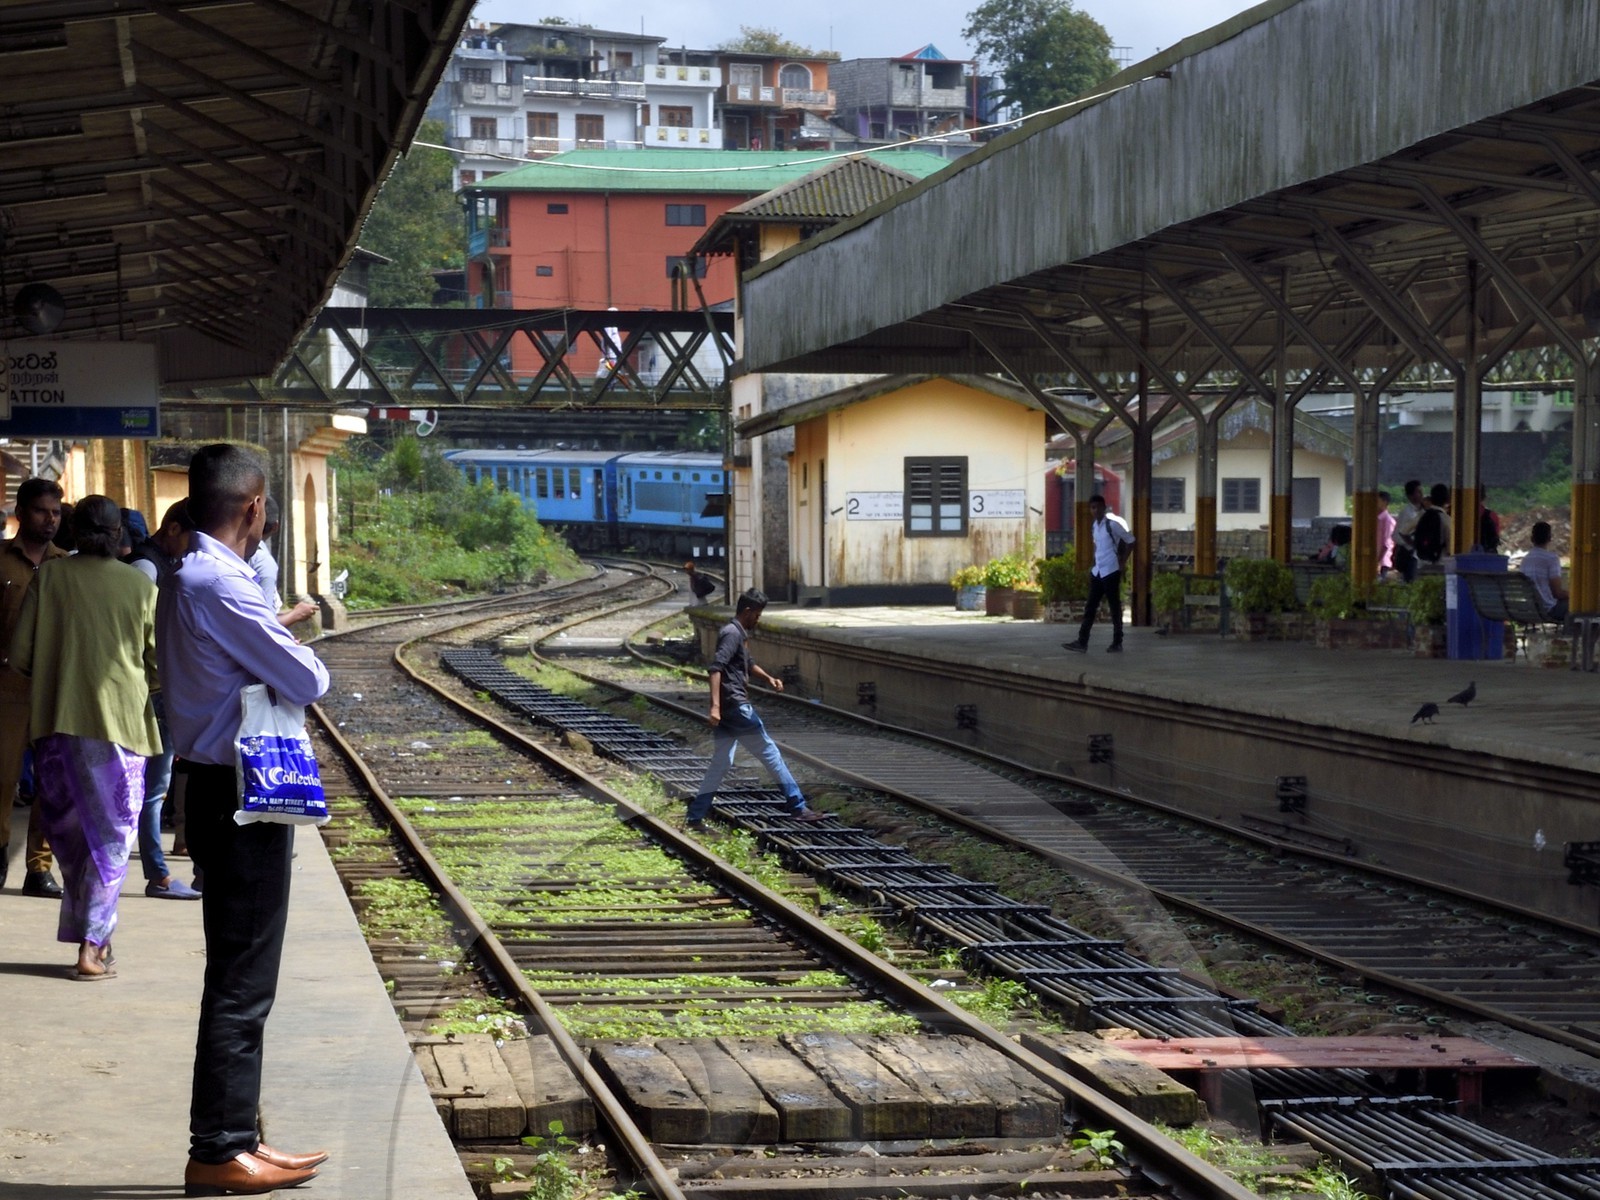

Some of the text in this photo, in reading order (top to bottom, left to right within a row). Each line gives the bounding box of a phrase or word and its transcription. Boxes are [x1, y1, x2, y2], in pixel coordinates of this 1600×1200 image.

[10, 390, 64, 403] ATTON
[848, 497, 860, 515] 2
[972, 495, 984, 513] 3
